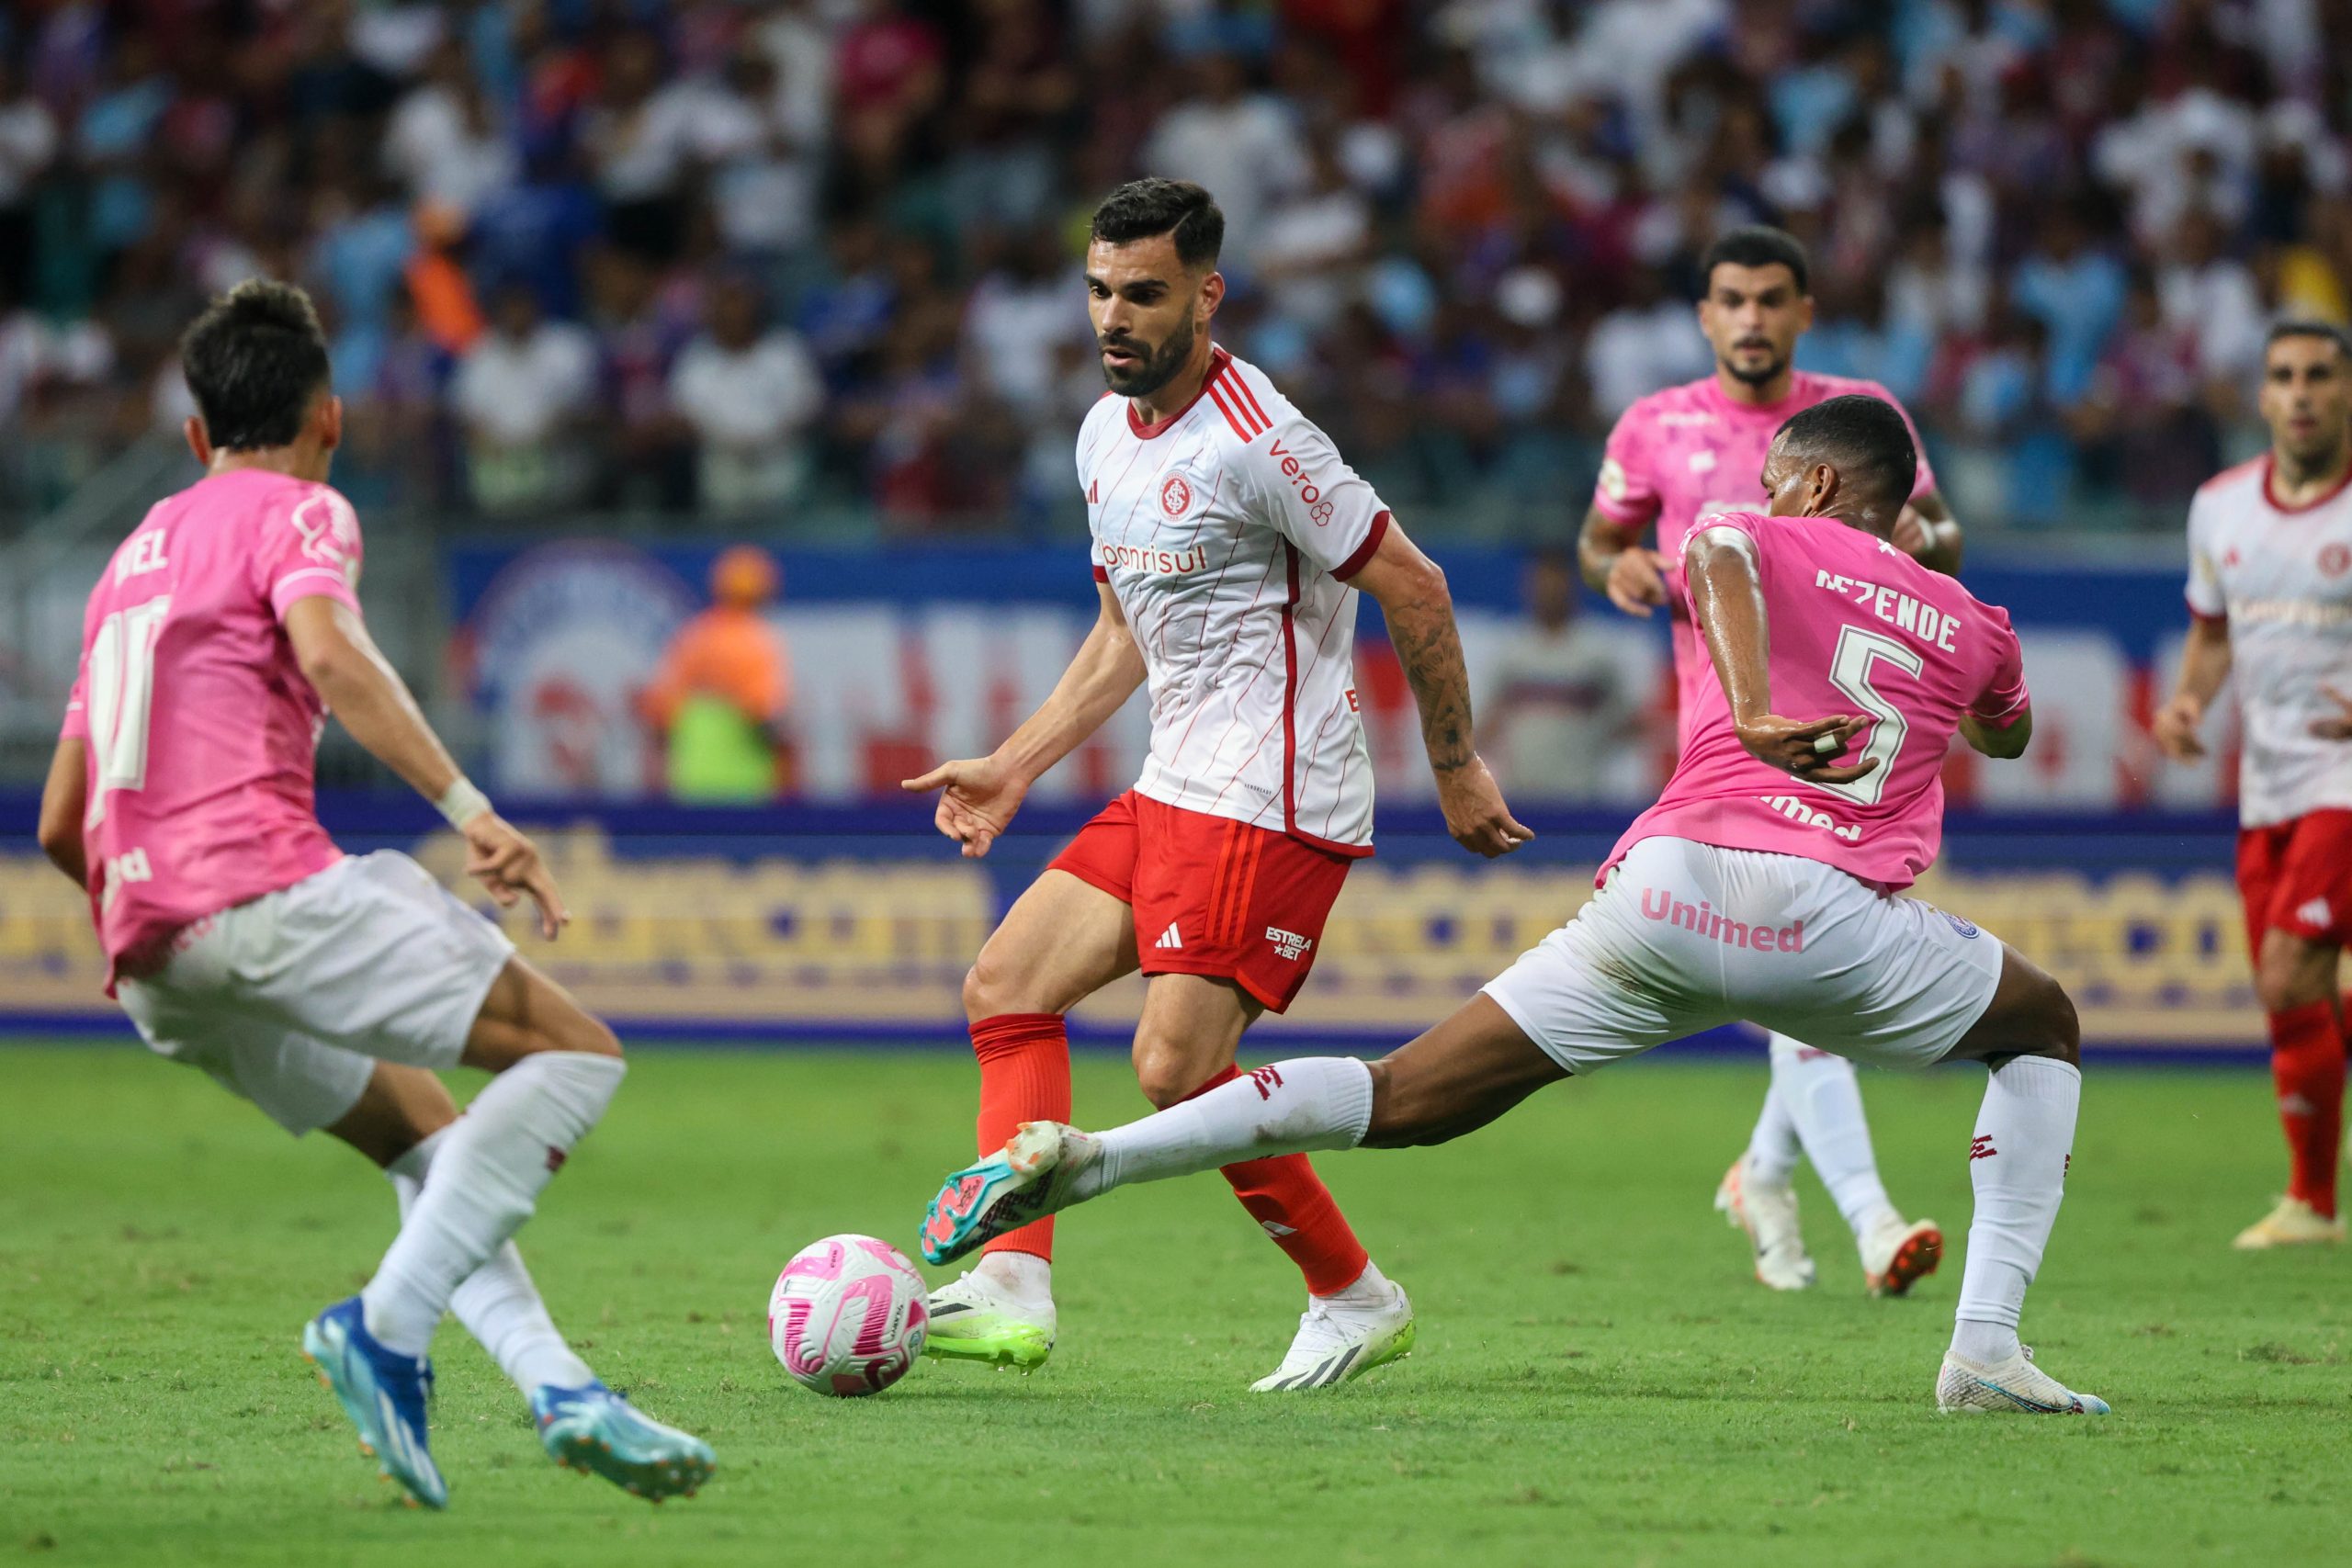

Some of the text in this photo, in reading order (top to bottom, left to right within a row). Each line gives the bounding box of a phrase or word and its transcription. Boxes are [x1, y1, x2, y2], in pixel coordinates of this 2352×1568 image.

[1270, 439, 1319, 503] vero
[1791, 624, 1924, 806] 5
[1265, 926, 1312, 952] ESTRELA
[1641, 887, 1804, 953] Unimed
[1282, 944, 1302, 961] BET
